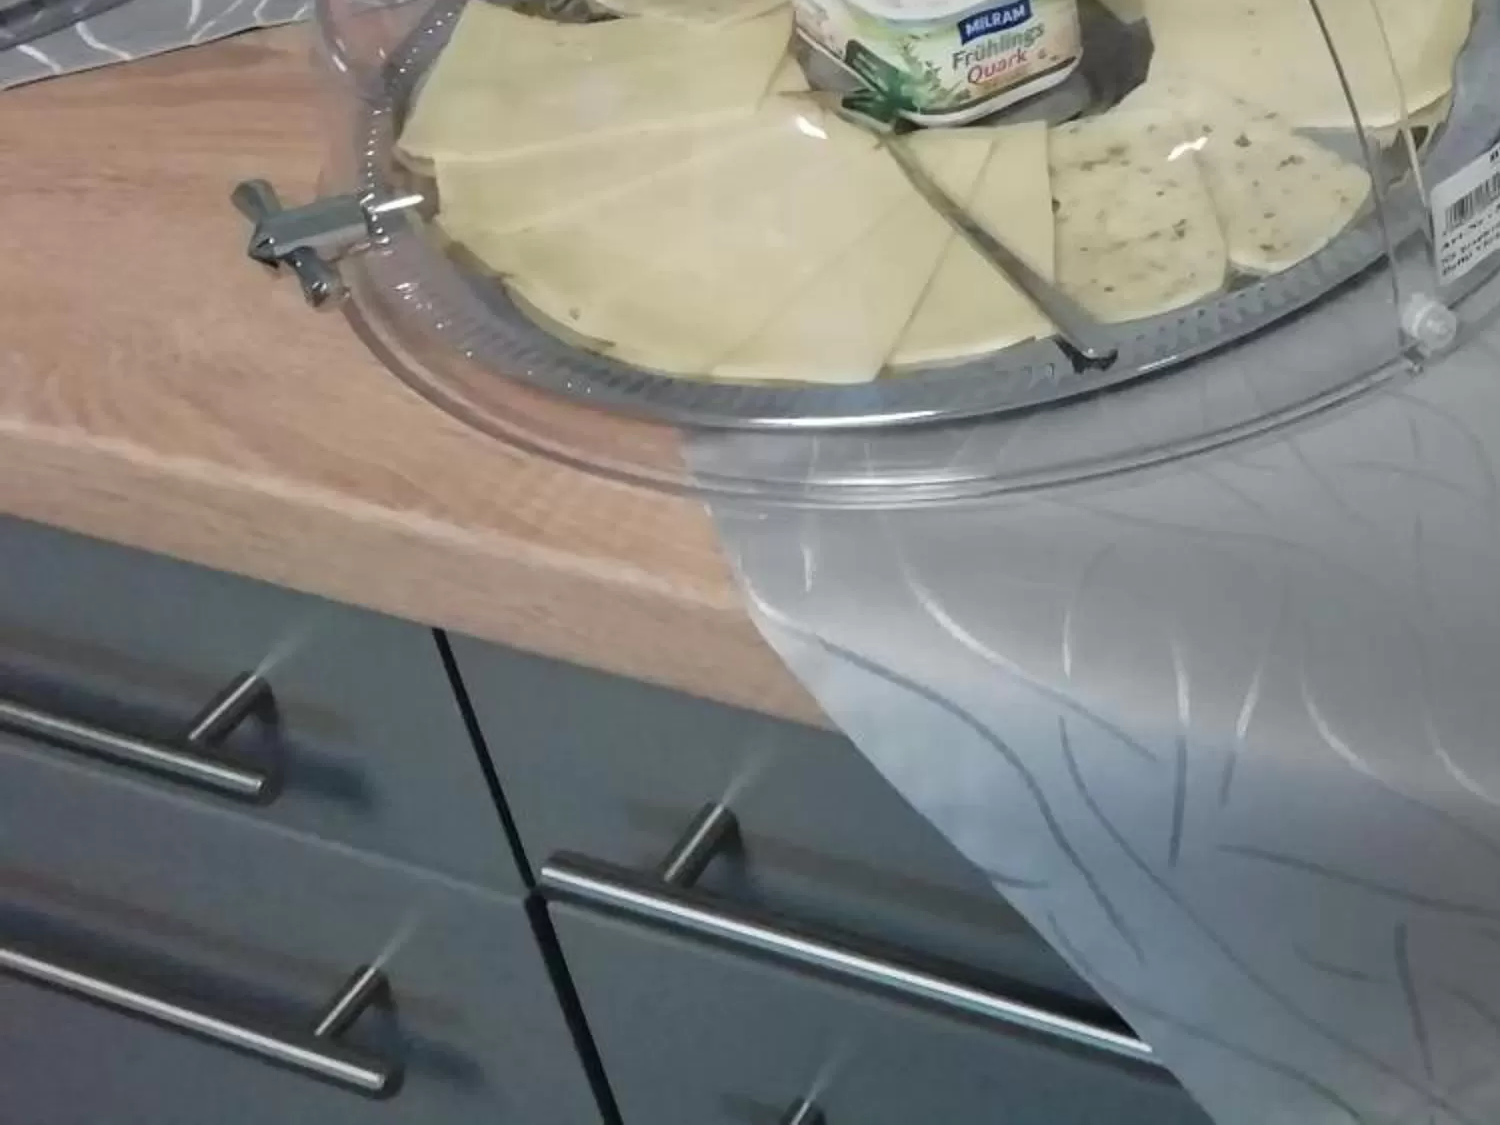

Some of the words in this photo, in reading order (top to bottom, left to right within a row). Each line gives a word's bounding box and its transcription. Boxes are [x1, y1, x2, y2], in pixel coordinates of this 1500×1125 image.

[965, 5, 1025, 36] MILRAM
[952, 23, 1043, 70] Frühlings
[969, 47, 1026, 83] Quark
